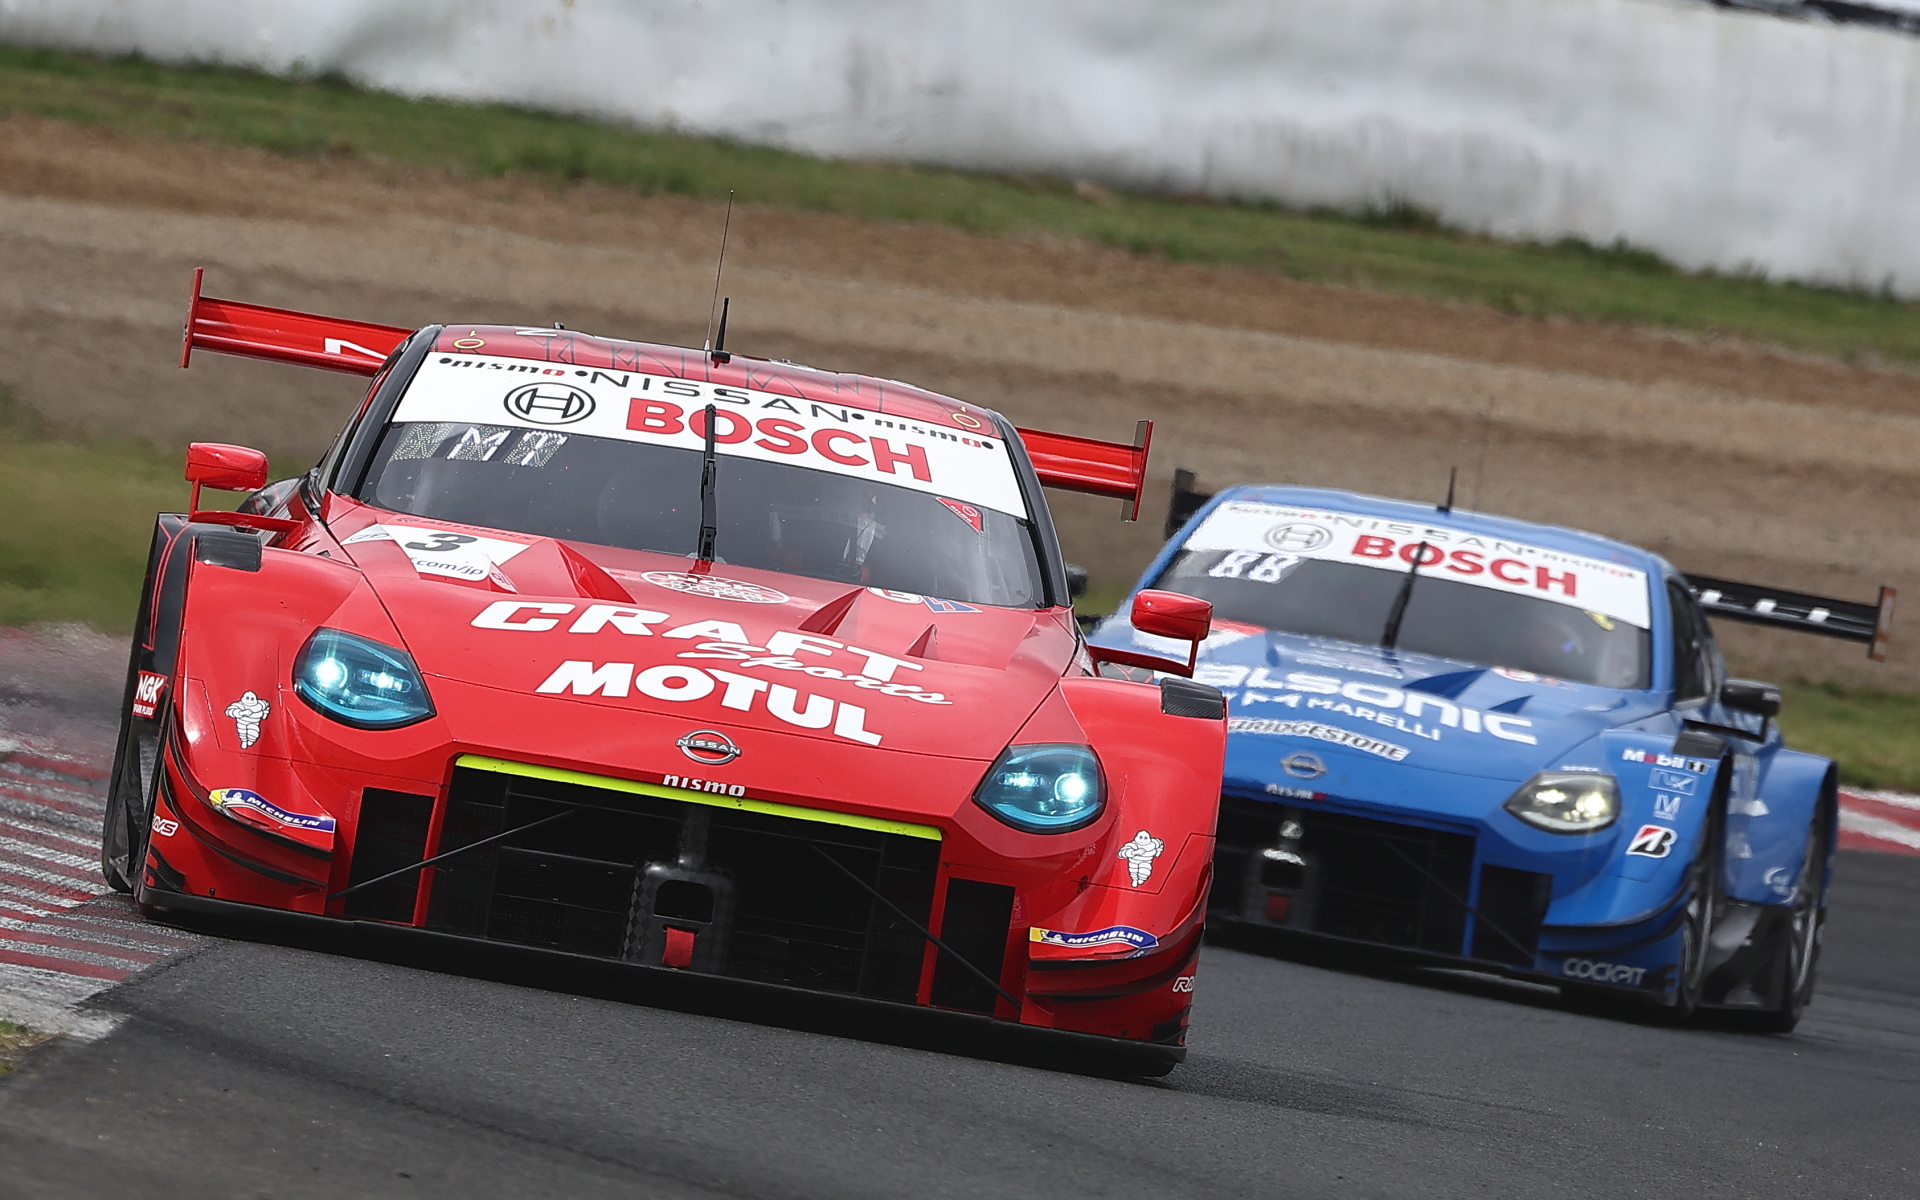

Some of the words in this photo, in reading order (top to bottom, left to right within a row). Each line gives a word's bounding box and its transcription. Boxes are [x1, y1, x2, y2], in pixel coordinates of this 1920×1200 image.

[590, 371, 848, 423] NISSAN
[626, 397, 933, 483] BOSCH
[874, 419, 982, 449] nismo
[404, 532, 479, 552] 3
[1331, 515, 1523, 556] NISSAN
[1351, 533, 1577, 598] BOSCH
[471, 601, 924, 683] CRAFT
[135, 674, 165, 705] NGK
[676, 642, 954, 706] Sports
[534, 660, 884, 748] MOTUL
[1306, 697, 1441, 742] MARELLI
[677, 738, 741, 755] NISSAN
[1622, 747, 1686, 769] Mobil
[663, 773, 746, 798] nismo
[246, 796, 321, 828] MICHELIN
[1066, 929, 1144, 945] MICHELIN
